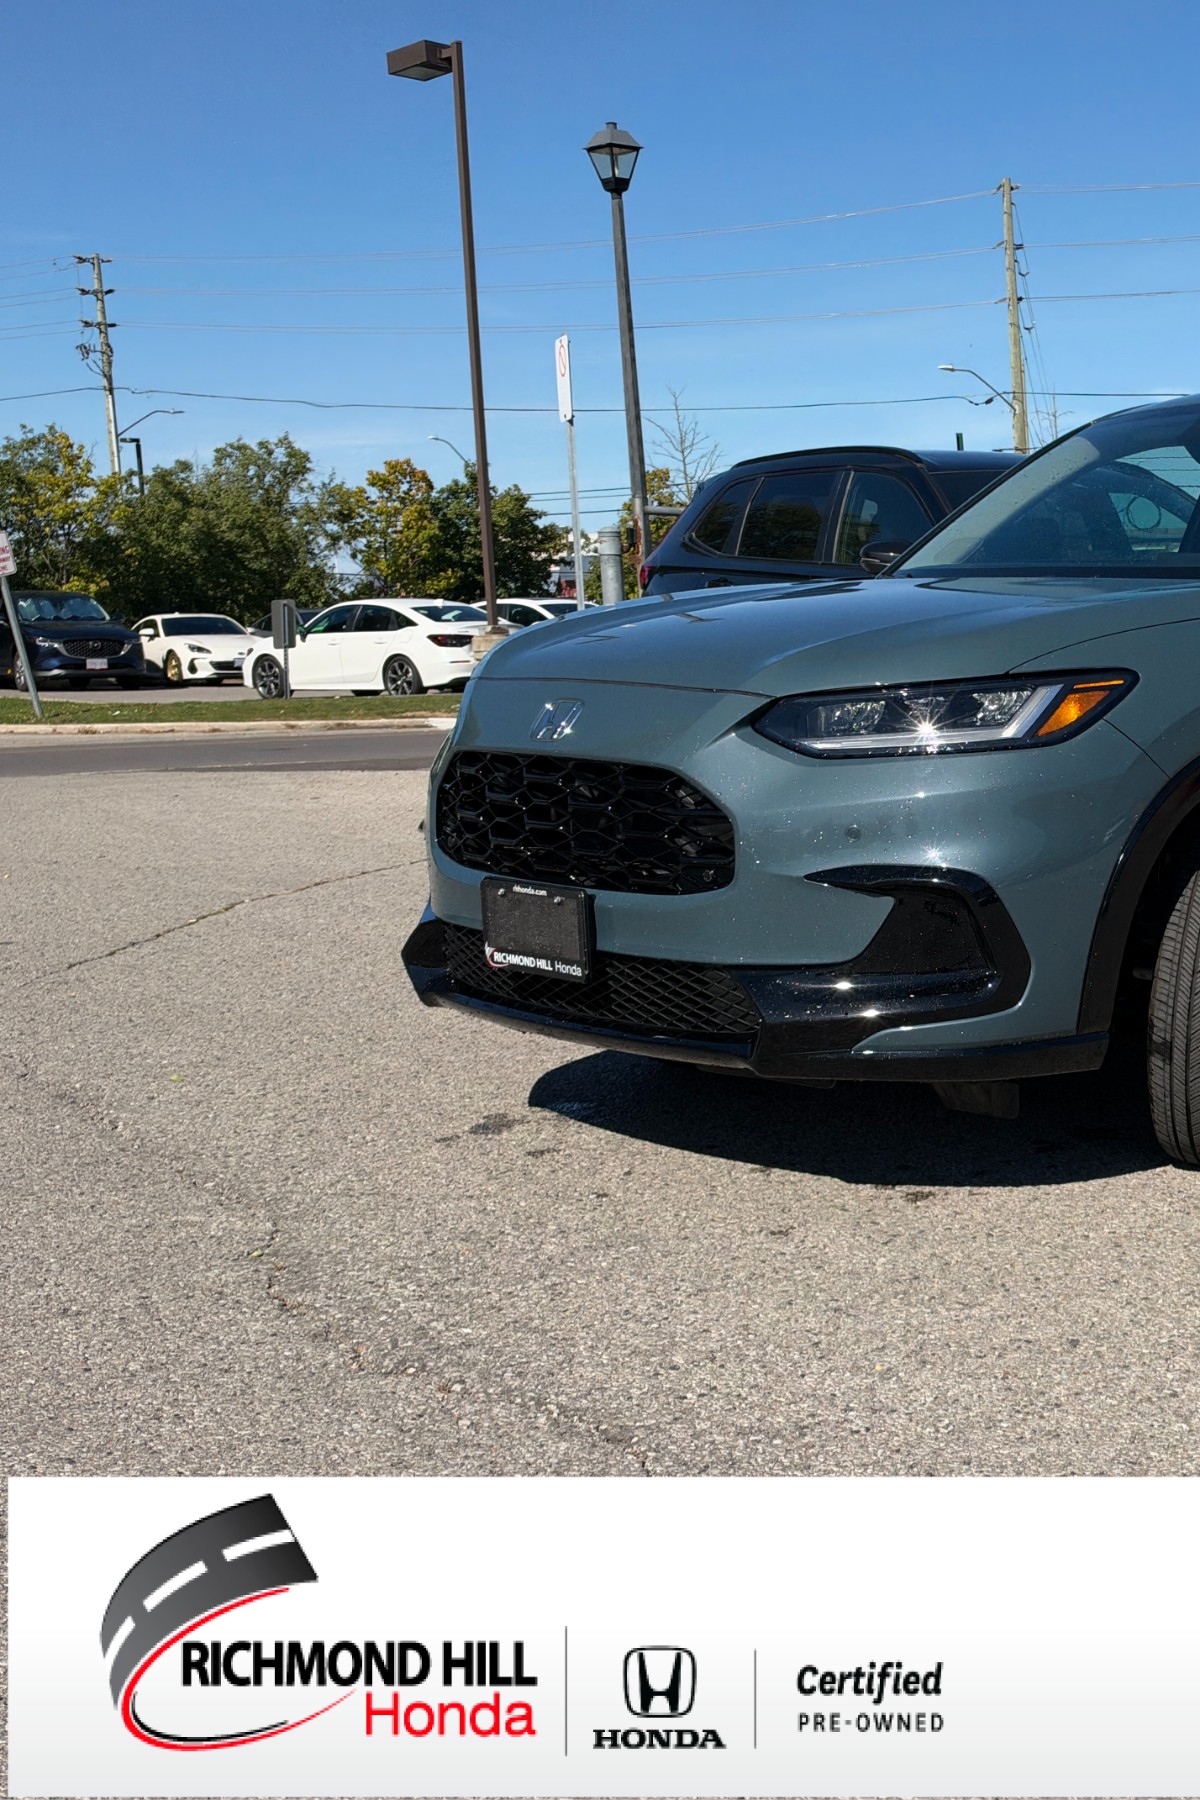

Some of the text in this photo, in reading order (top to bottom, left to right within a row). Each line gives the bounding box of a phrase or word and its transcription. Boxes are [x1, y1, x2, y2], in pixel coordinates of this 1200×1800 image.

[493, 951, 582, 977] RICHMOND HILL Honda
